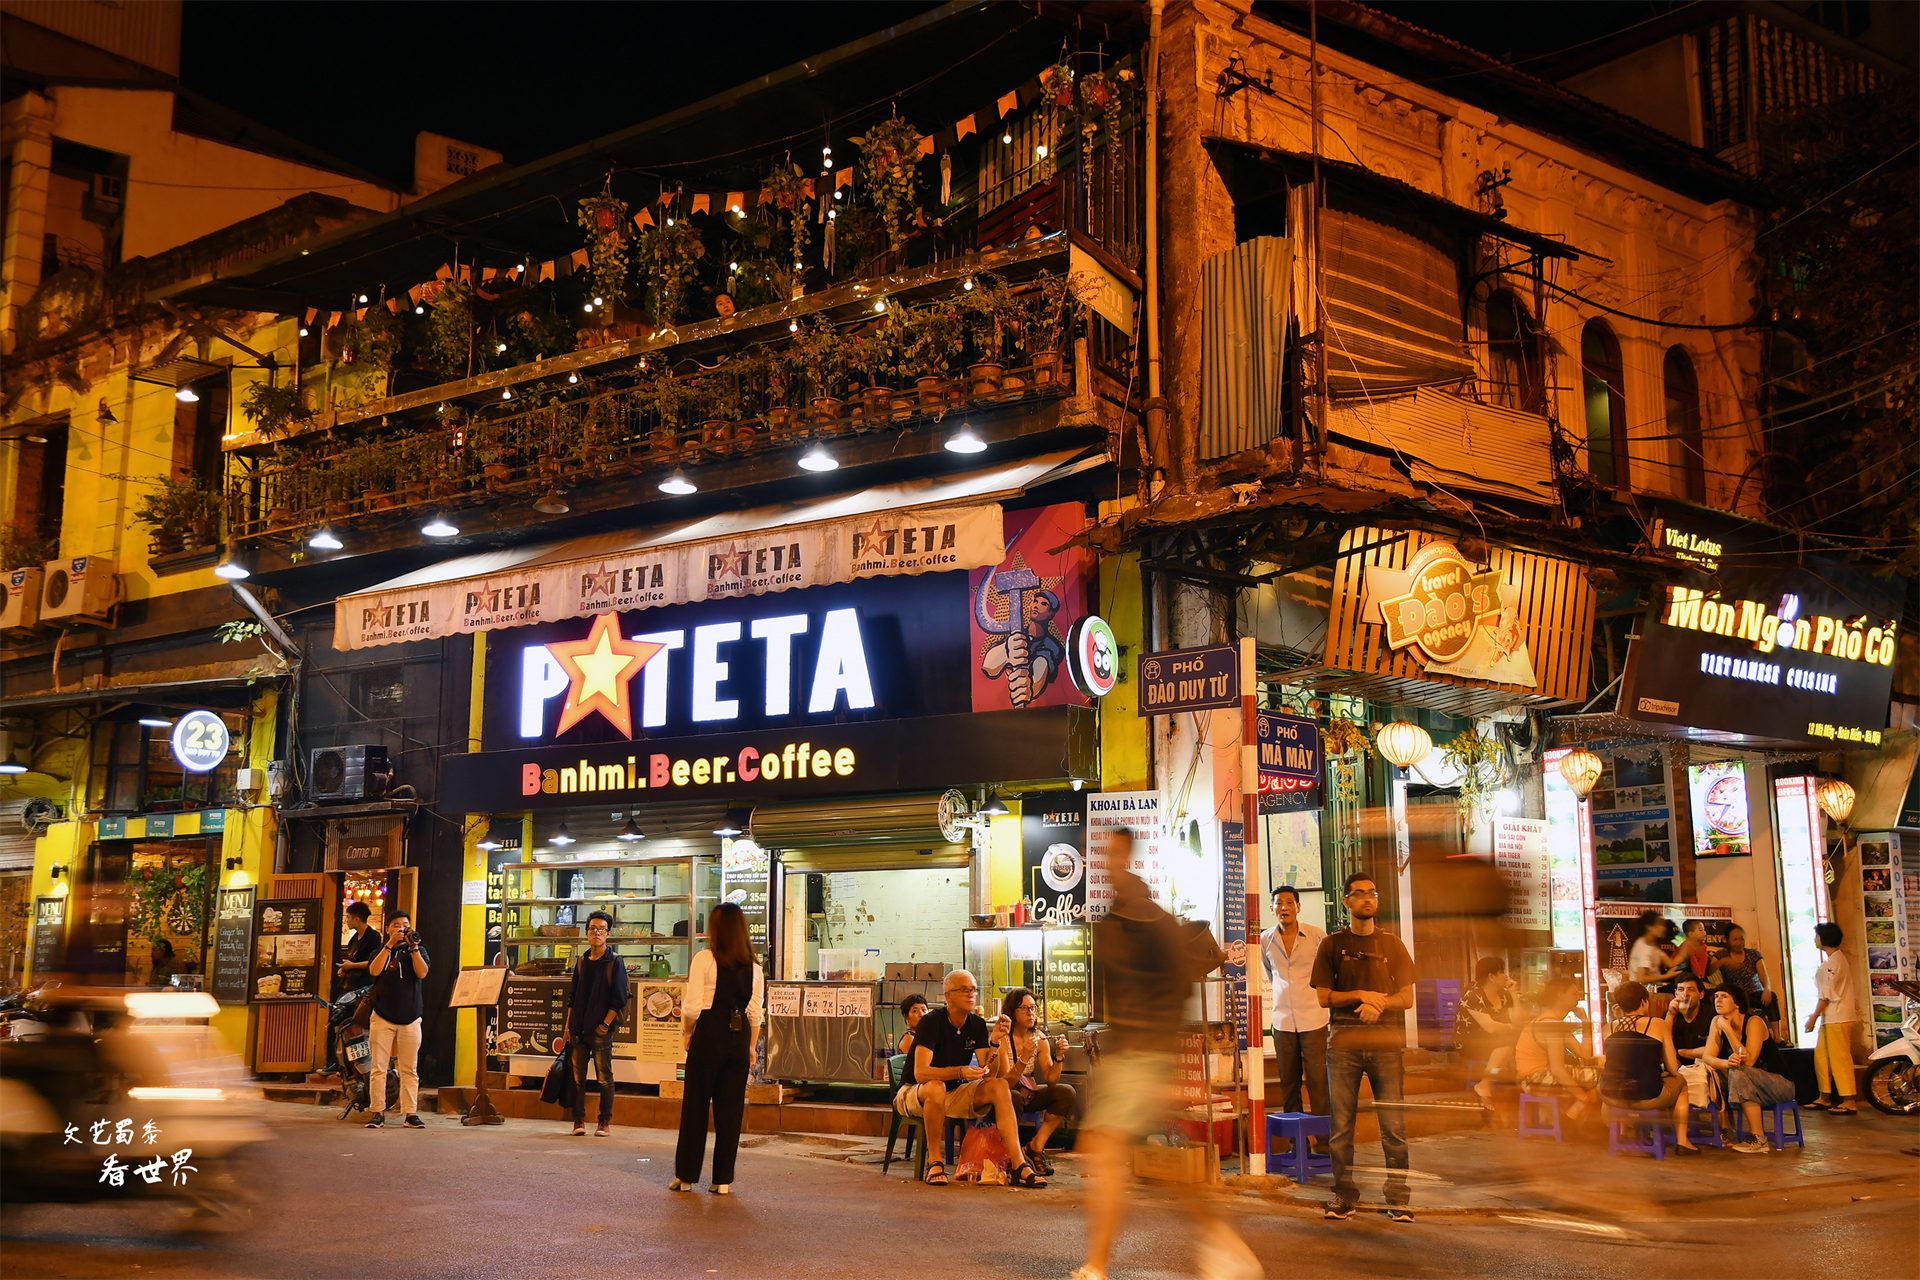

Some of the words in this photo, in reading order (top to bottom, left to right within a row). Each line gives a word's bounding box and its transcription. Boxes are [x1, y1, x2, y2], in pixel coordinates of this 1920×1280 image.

[1665, 527, 1689, 550] Viet
[1689, 533, 1723, 557] Lotus
[1421, 566, 1461, 593] travel
[1423, 620, 1471, 650] agency
[1811, 615, 1868, 661] Phố
[1864, 618, 1897, 667] Cổ
[1172, 654, 1205, 675] PHỐ
[1147, 678, 1176, 705] ĐÀO
[1179, 678, 1206, 702] DUY
[1209, 670, 1229, 698] TỪ
[1785, 667, 1838, 695] CUISINE
[186, 720, 223, 751] 23
[1277, 724, 1299, 740] PHỐ
[1261, 740, 1284, 767] MÃ
[1286, 743, 1314, 771] MÂY
[1776, 777, 1804, 786] BOOKING
[1778, 786, 1805, 796] OFFICE
[1090, 800, 1121, 811] KHOAI
[1122, 797, 1136, 810] BÀ
[1138, 799, 1158, 810] LAN
[1258, 791, 1309, 808] AGENCY
[1090, 817, 1101, 827] KHOAI
[1102, 817, 1112, 826] LANG
[1119, 816, 1135, 826] PHOMAI
[1521, 823, 1543, 833] KHÁT
[1090, 832, 1101, 842] KHOAI
[346, 845, 370, 860] Come
[370, 846, 380, 858] in
[1149, 845, 1159, 855] 50K
[751, 860, 763, 872] 30
[1134, 860, 1144, 870] 50K
[1508, 861, 1521, 869] TIGER
[750, 892, 759, 902] 35
[1090, 890, 1100, 899] NEM
[223, 894, 250, 909] MENU
[40, 902, 63, 916] MENU
[1031, 892, 1087, 926] Coffee
[749, 924, 759, 934] 30
[1059, 960, 1088, 973] loca
[1051, 974, 1086, 986] Indigenou
[536, 1032, 548, 1040] Free
[350, 1048, 371, 1060] 9823
